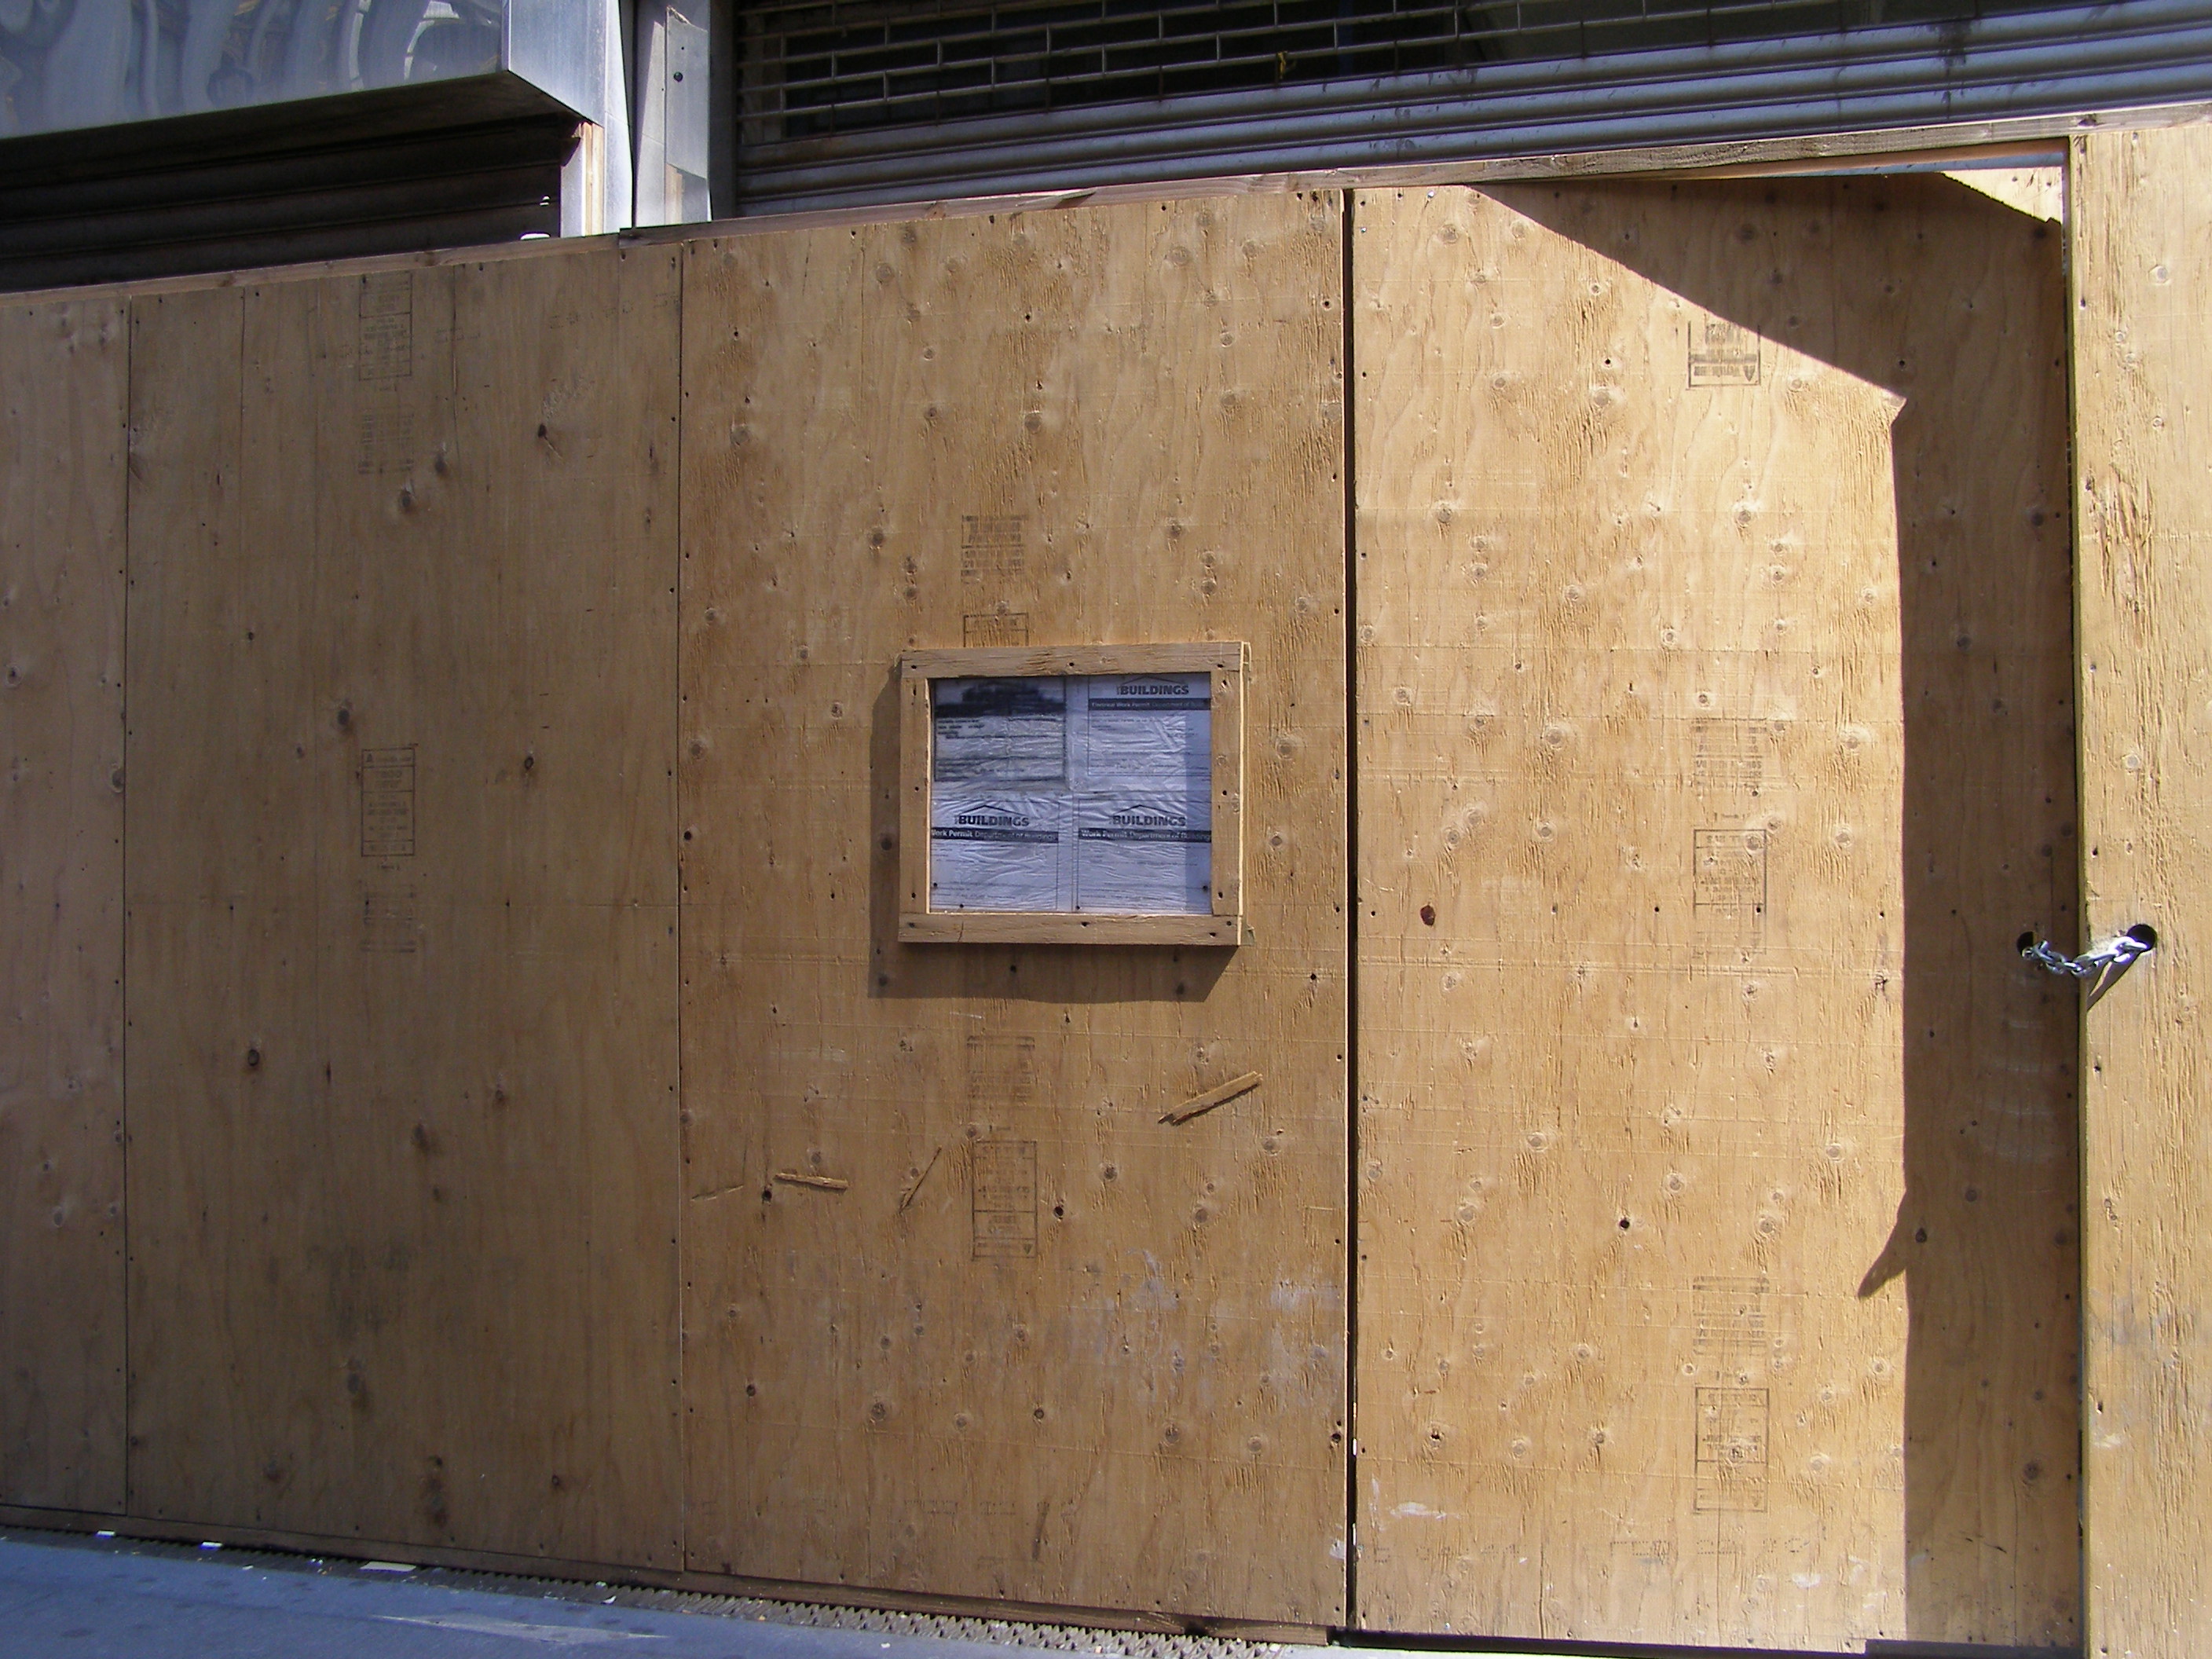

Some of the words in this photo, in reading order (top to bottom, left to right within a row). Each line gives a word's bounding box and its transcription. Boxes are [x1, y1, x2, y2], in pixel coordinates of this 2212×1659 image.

[1120, 684, 1189, 695] BUILDINGS
[958, 815, 1030, 826] BUILDINGS
[1112, 815, 1186, 826] BUILDINGS
